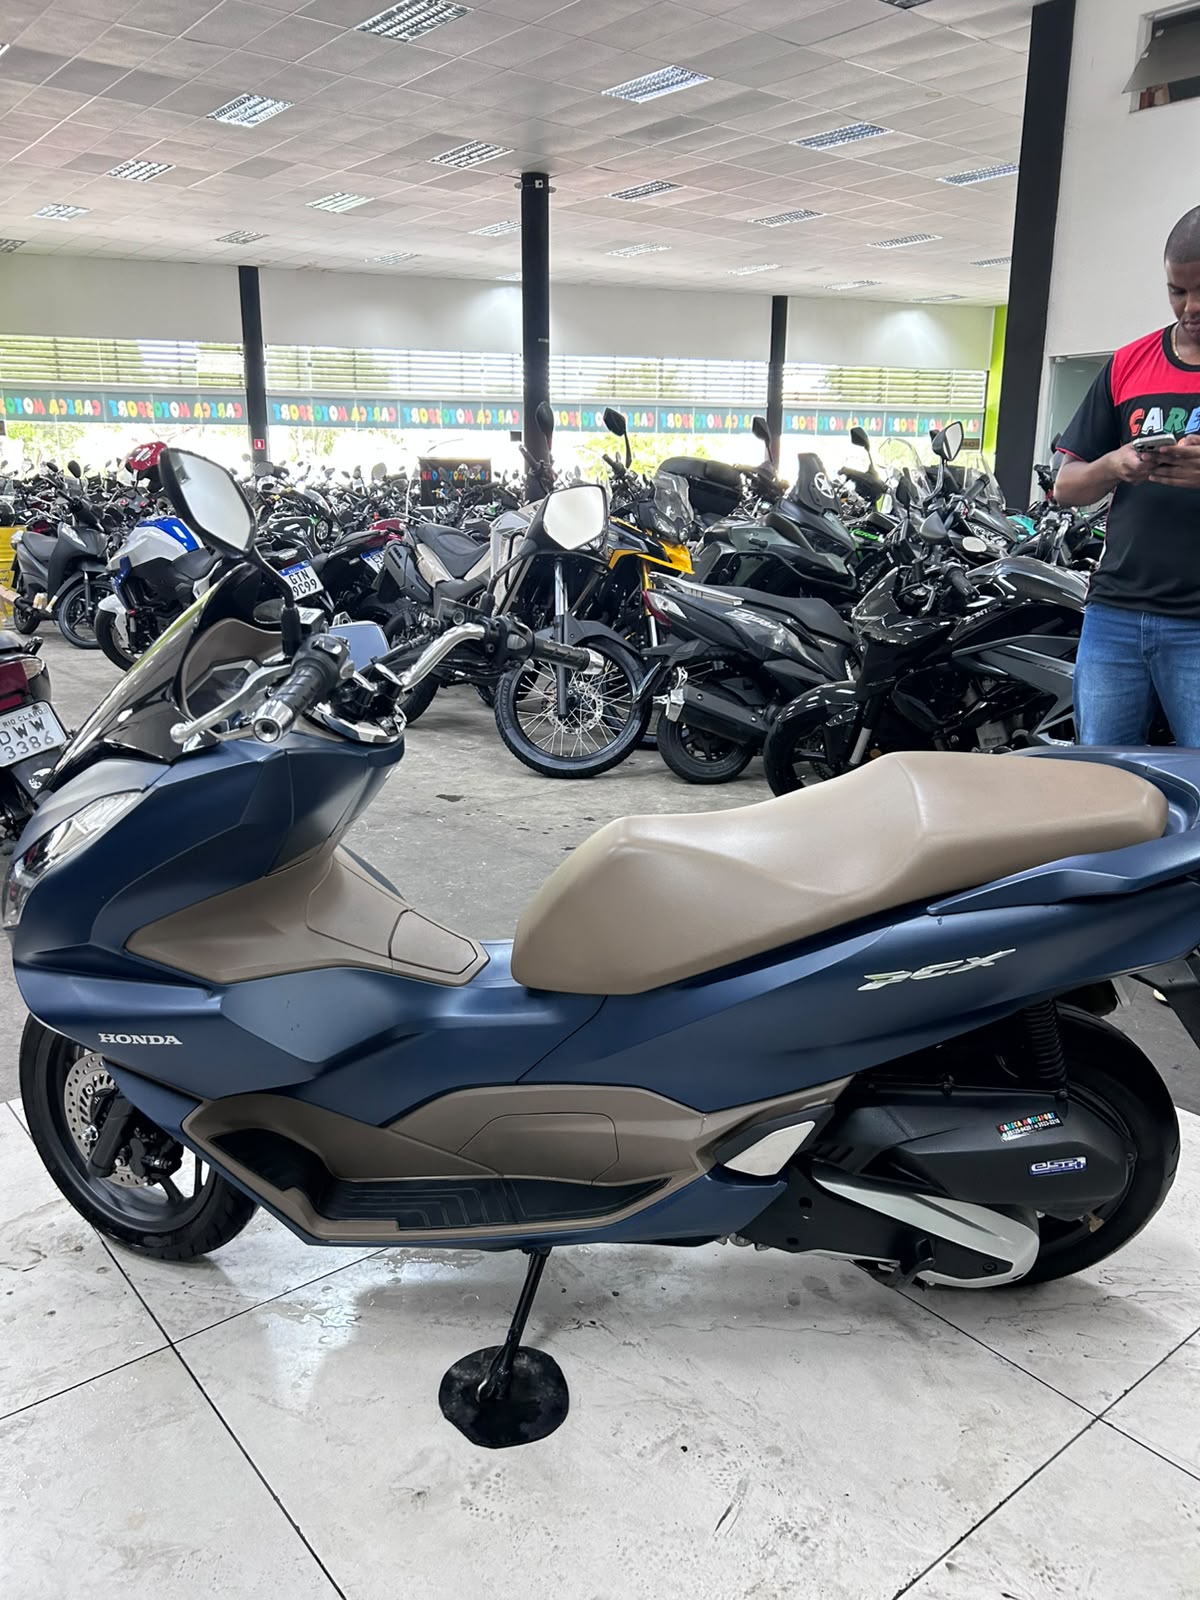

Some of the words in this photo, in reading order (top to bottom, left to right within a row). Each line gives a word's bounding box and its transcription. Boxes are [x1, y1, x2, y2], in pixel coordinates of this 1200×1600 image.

[289, 569, 310, 584] GTN
[292, 578, 317, 596] 9C99
[17, 708, 43, 722] CLARO
[4, 730, 54, 759] 3386
[857, 948, 1016, 991] PCX
[98, 1032, 183, 1045] HONDA
